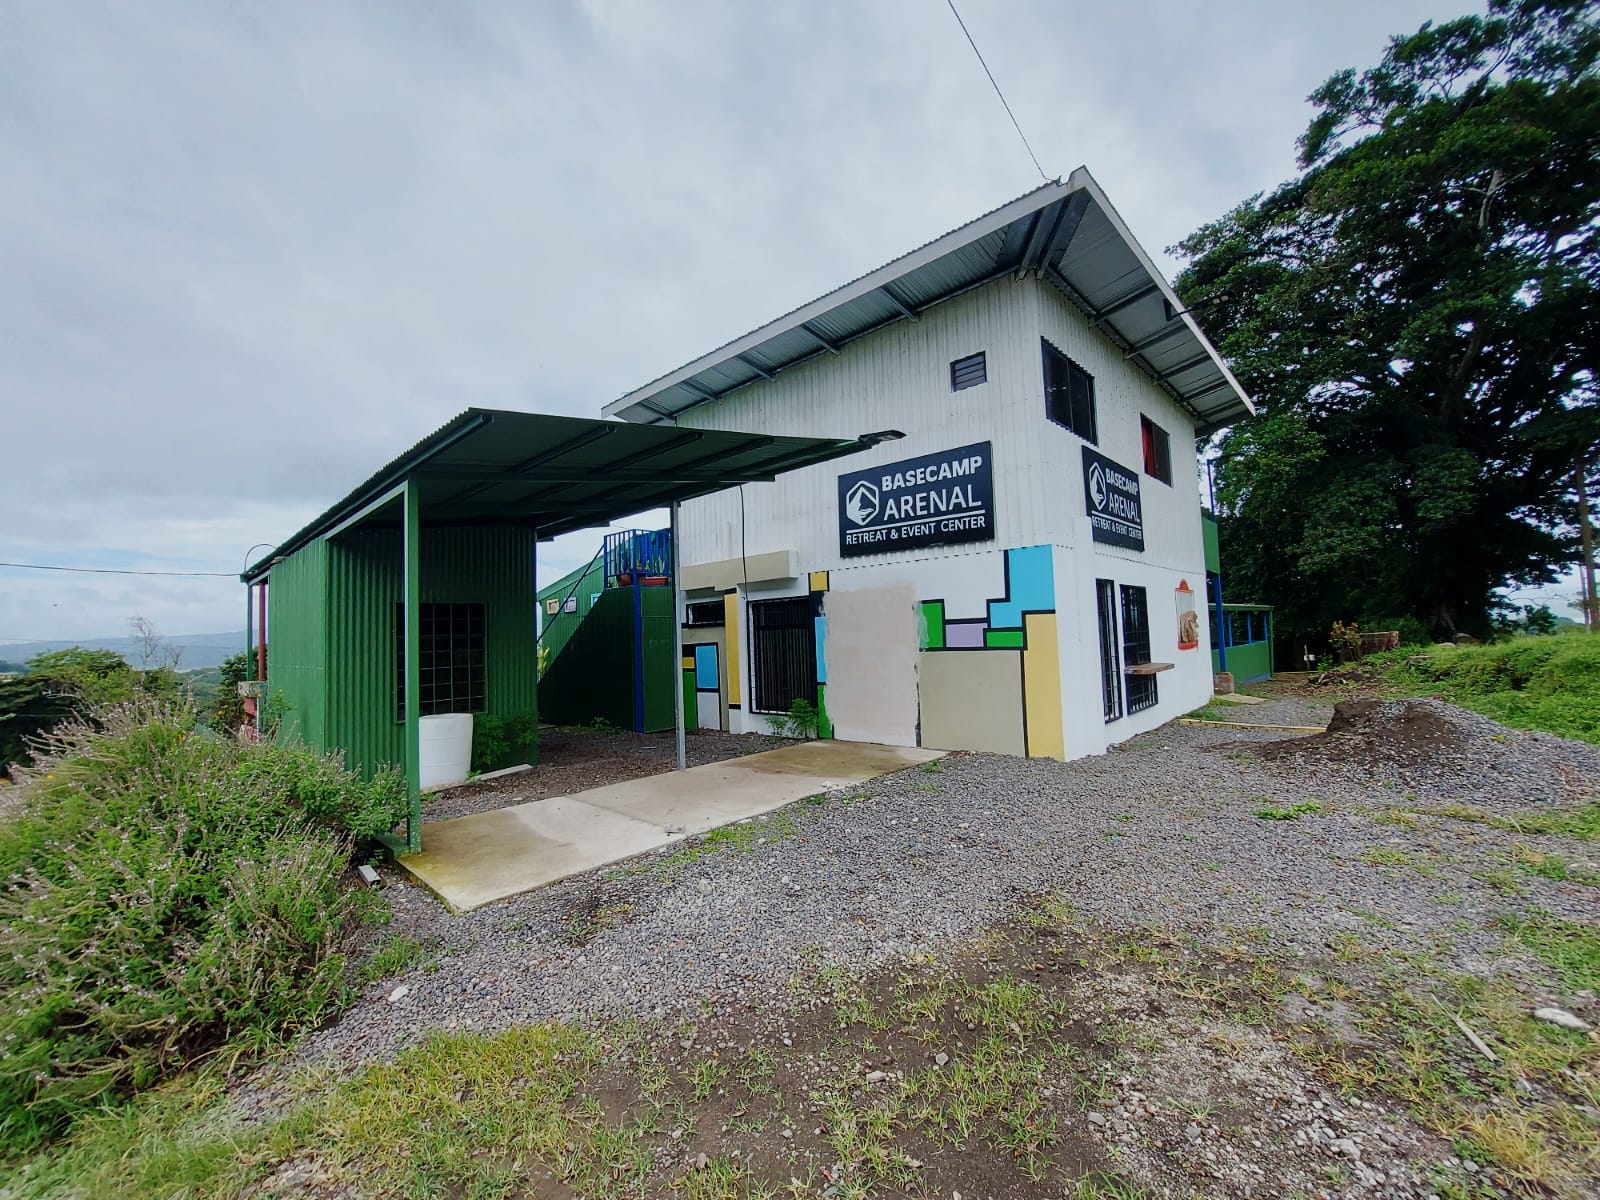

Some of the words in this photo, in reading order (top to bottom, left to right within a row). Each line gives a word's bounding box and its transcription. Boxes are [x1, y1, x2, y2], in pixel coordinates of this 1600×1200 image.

[881, 456, 982, 492] BASECAMP
[1106, 468, 1138, 495] BASECAMP
[883, 484, 982, 521] ARENAL
[1109, 492, 1140, 522] ARENAL
[846, 530, 886, 545] RETREAT
[890, 529, 898, 539] &
[902, 523, 936, 538] EVENT
[941, 516, 986, 532] CENTER
[1092, 516, 1111, 530] RETREAT
[1116, 523, 1128, 535] EVENT
[1129, 527, 1142, 540] CENTER
